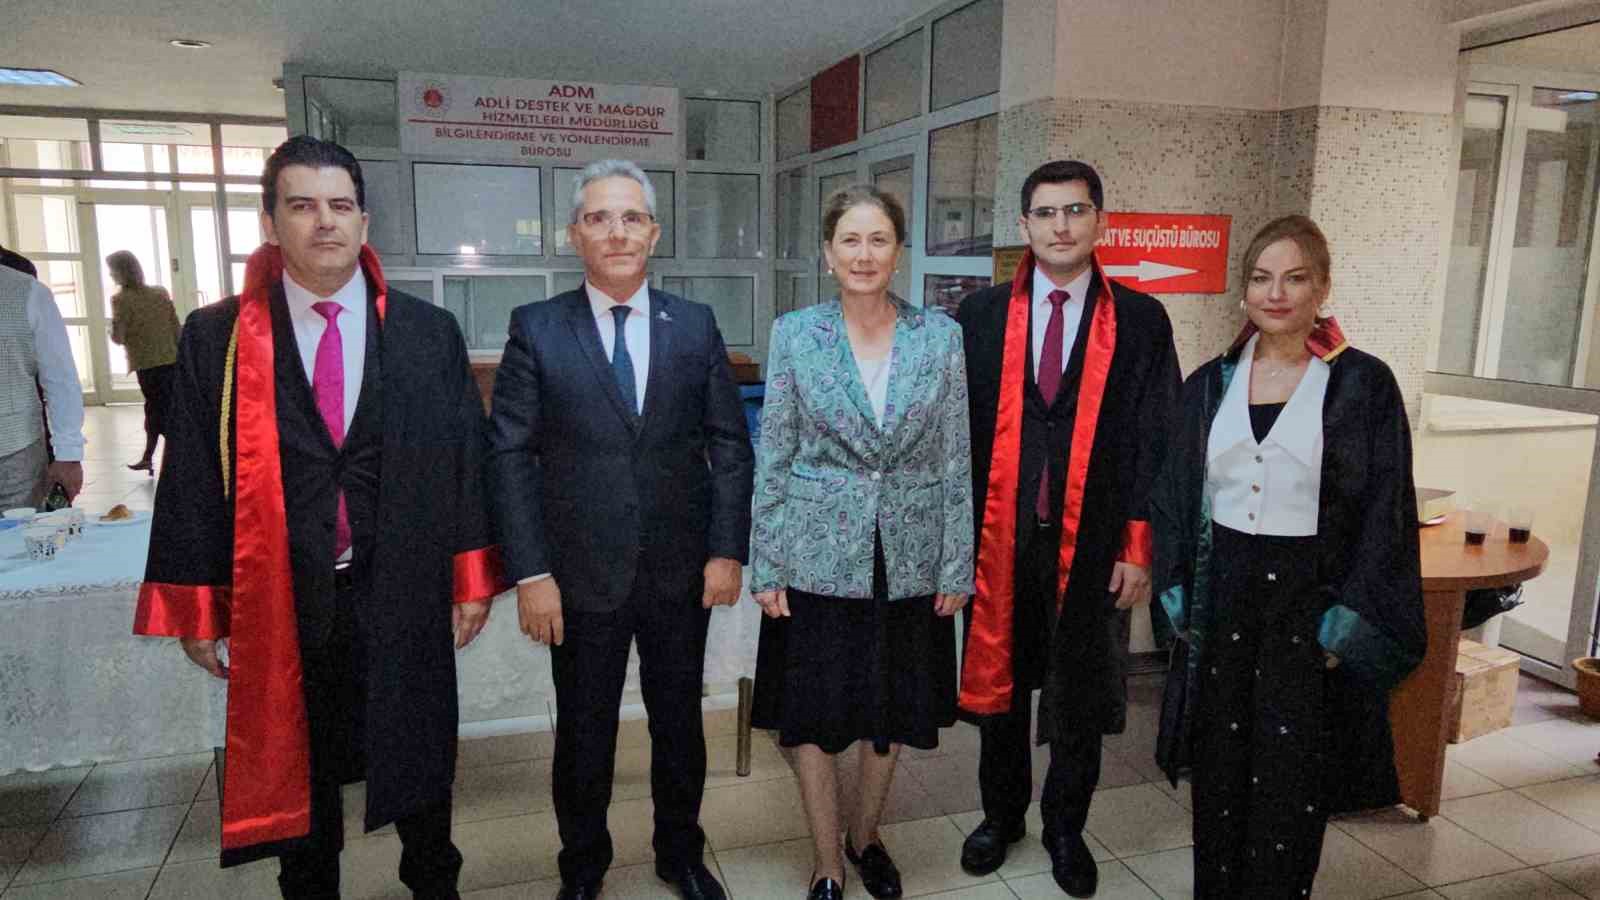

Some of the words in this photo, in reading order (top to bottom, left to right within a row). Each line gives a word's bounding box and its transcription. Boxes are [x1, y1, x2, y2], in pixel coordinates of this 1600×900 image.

[549, 85, 594, 98] ADM
[475, 96, 510, 109] ADLİ
[515, 99, 569, 112] DESTEK
[575, 102, 592, 113] VE
[599, 102, 665, 117] MAĞDUR
[541, 132, 556, 142] VE
[1118, 228, 1131, 247] VE
[1132, 224, 1178, 252] SUÇÜSTÜ
[1179, 224, 1220, 248] BÜROSU
